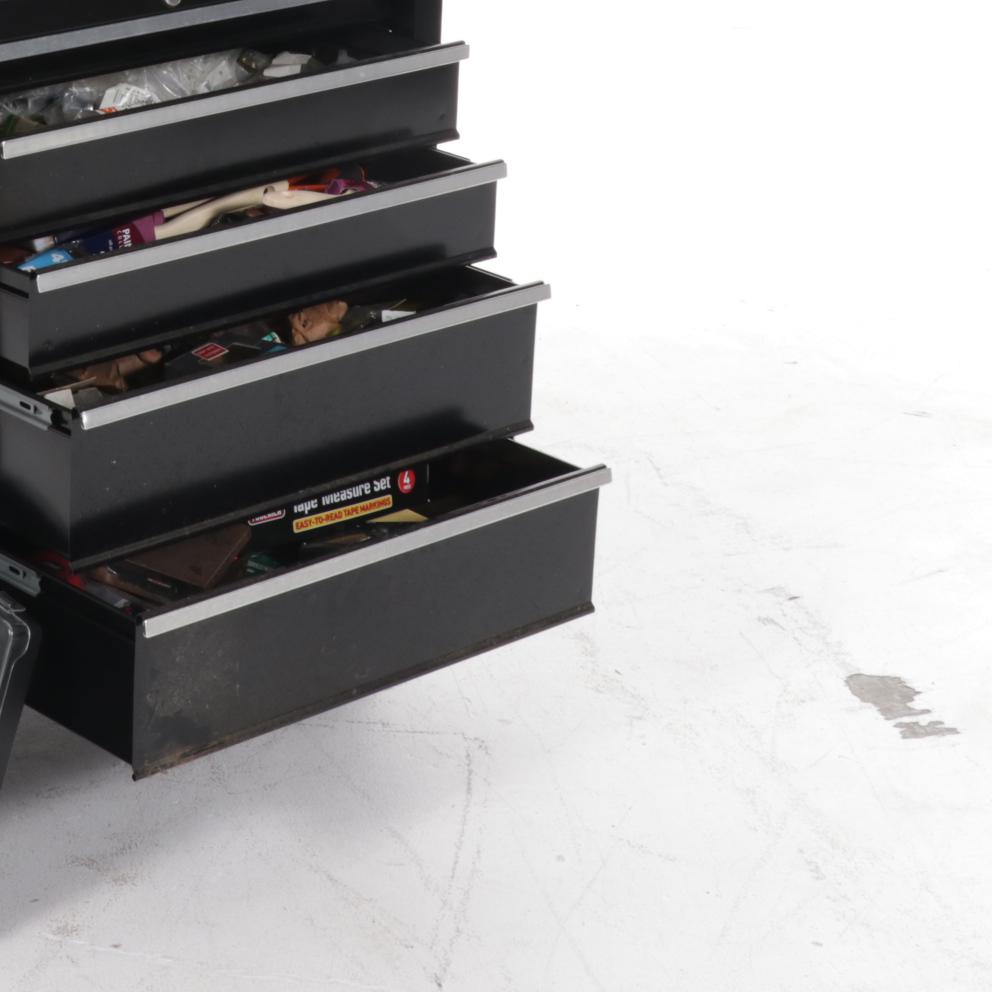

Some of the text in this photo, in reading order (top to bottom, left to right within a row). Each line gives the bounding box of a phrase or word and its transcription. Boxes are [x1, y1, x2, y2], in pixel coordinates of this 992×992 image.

[321, 482, 371, 506] Measure
[373, 476, 391, 492] Set
[403, 470, 411, 484] 4
[295, 511, 343, 530] EASY-TO-READ
[343, 505, 360, 517] TAPE
[359, 496, 391, 515] MARKINGS
